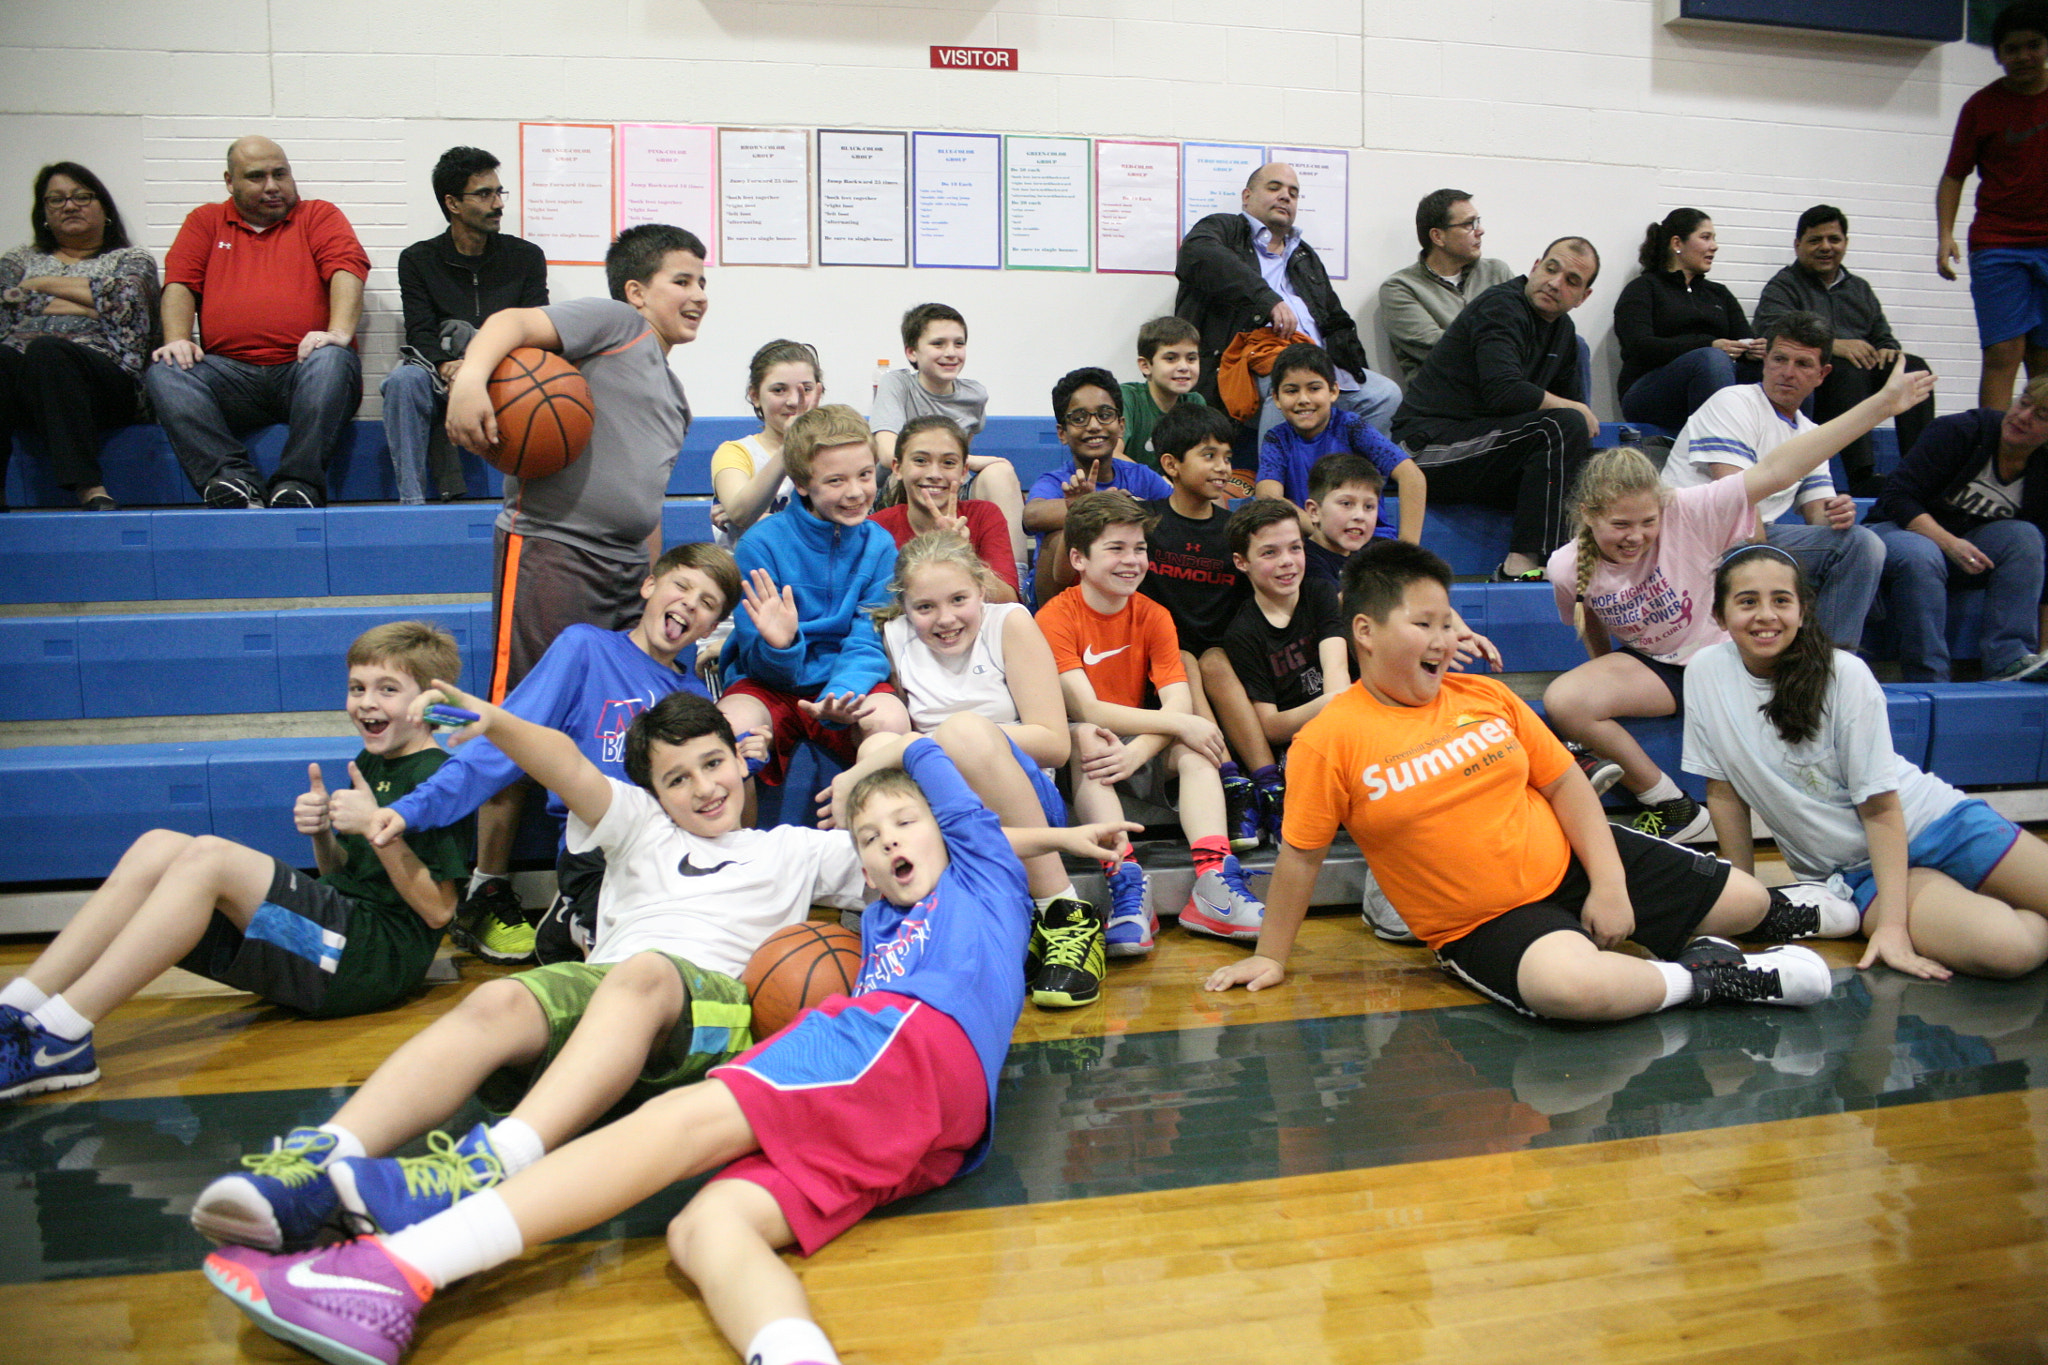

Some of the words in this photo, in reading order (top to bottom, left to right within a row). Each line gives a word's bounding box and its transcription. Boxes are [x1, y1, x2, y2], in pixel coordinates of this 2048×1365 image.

[938, 49, 1010, 67] VISITOR
[1154, 550, 1225, 571] UNDER
[1148, 561, 1236, 587] ARMOUR
[1591, 593, 1618, 608] HOPE
[1620, 580, 1648, 602] FIGHT
[1646, 577, 1670, 602] LIKE
[1648, 587, 1677, 610] FAITH
[1643, 600, 1682, 626] POWER
[1384, 743, 1426, 765] Greenhill
[1424, 732, 1451, 748] School
[1463, 762, 1481, 777] on
[1482, 749, 1505, 767] the
